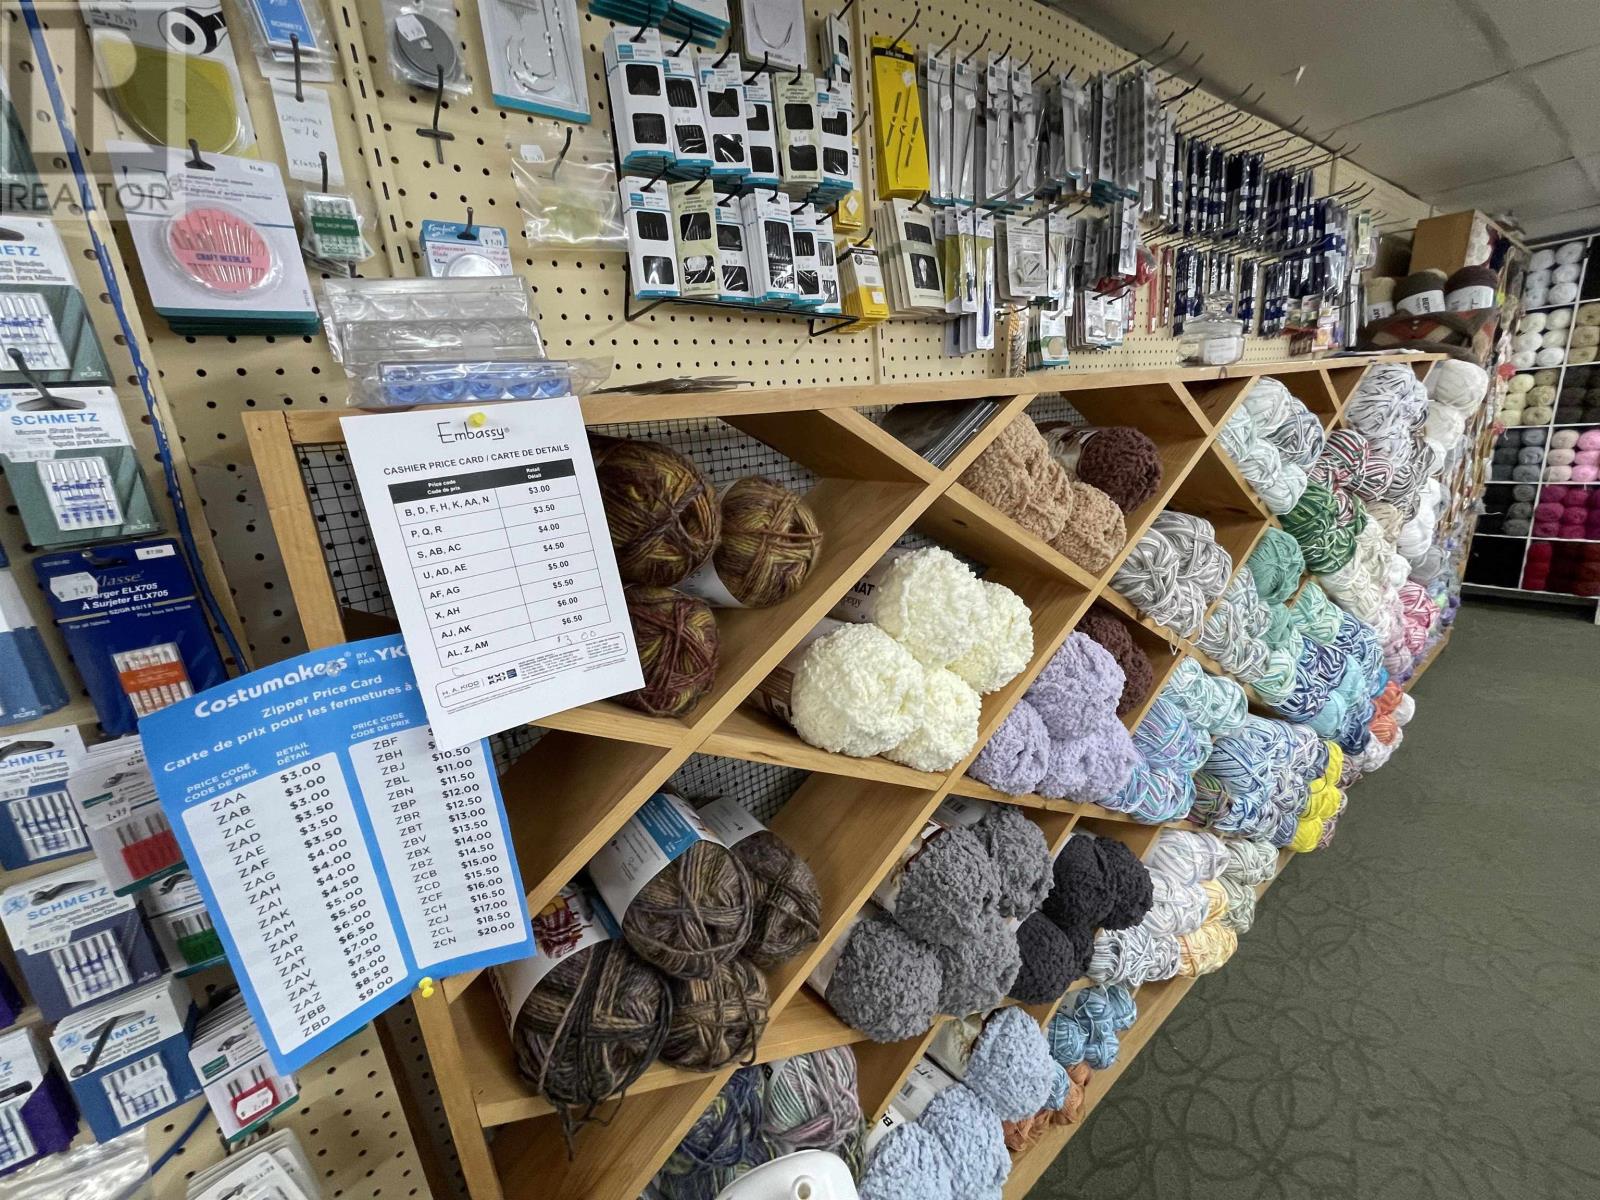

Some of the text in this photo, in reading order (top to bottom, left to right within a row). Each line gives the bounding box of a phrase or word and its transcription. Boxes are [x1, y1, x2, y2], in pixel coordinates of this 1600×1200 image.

[10, 412, 99, 426] SCHMETZ
[437, 421, 505, 443] Embassy
[383, 463, 427, 476] CASHIER
[429, 459, 456, 469] PRICE
[459, 454, 484, 465] CARD
[491, 450, 520, 461] CARTE
[535, 444, 570, 455] DETAILS
[529, 484, 550, 494] $3.00
[405, 509, 416, 517] B,
[418, 506, 428, 515] D,
[430, 504, 439, 513] F,
[441, 502, 451, 511] H,
[453, 500, 463, 509] K,
[465, 498, 481, 507] AA,
[533, 504, 555, 514] $3.50
[411, 529, 420, 538] P,
[422, 527, 433, 536] Q,
[538, 522, 560, 533] $4.00
[417, 544, 462, 559] S, AB, AC
[543, 542, 565, 552] $4.50
[423, 563, 468, 580] U, AD, AE
[548, 560, 569, 571] $5.00
[122, 583, 157, 595] ELX705
[429, 586, 460, 600] AF, AG
[553, 579, 574, 589] $5.50
[82, 590, 168, 610] À Surjeter ELX705
[435, 607, 460, 620] X, AH
[557, 597, 578, 607] $6.00
[441, 625, 472, 639] AJ, AK
[562, 615, 583, 625] $6.50
[356, 652, 368, 660] BY
[358, 657, 375, 666] PAR
[447, 641, 489, 659] AL, Z, AM
[194, 655, 348, 718] Costumakes
[262, 674, 382, 719] Zipper Price Card
[163, 749, 209, 773] Carte
[213, 738, 233, 753] de
[237, 725, 267, 745] prix
[271, 712, 304, 734] pour
[308, 704, 328, 718] les
[330, 685, 402, 712] fermetures
[404, 682, 413, 692] à
[351, 719, 410, 740] CODE DE PRIX
[352, 712, 405, 731] PRICE CODE
[276, 741, 310, 758] RETAIL
[276, 749, 311, 766] DÉTAIL
[373, 737, 398, 751] ZBF
[376, 750, 403, 763] ZBH
[381, 746, 471, 775] ZBJ $10.50
[385, 759, 472, 788] ZBL $11.00
[184, 768, 259, 803] CODE DE PRIX
[187, 763, 251, 793] PRICE CODE
[211, 762, 321, 812] ZAA $3.00
[388, 772, 475, 800] ZBN $11.50
[216, 776, 326, 826] ZAB $3.00
[392, 784, 480, 812] ZBP $12.00
[395, 796, 482, 825] ZBR $12.50
[222, 788, 330, 839] ZAC $3.00
[226, 802, 333, 852] ZAD $3.50
[400, 808, 486, 836] ZBT $13.00
[233, 814, 338, 866] ZAE $3.50
[403, 820, 488, 849] ZBV $13.50
[407, 831, 492, 860] ZBX $14.00
[238, 827, 342, 878] ZAF $3.50
[243, 839, 347, 892] ZAG $4.00
[410, 843, 494, 872] ZBZ $14.50
[248, 852, 351, 904] ZAH $4.00
[414, 854, 497, 883] ZCB $15.00
[417, 866, 499, 894] ZCD $15.50
[256, 864, 355, 915] ZAI $4.00
[259, 876, 359, 929] ZAK $4.50
[421, 877, 503, 905] ZCF $16.00
[423, 888, 505, 916] ZCH $16.50
[26, 887, 109, 921] SCHMETZ
[262, 888, 363, 941] ZAM $5.00
[428, 900, 508, 927] ZCJ $17.00
[269, 899, 366, 953] ZAP $5.50
[273, 910, 371, 966] ZAR $6.00
[431, 911, 510, 938] ZCL $18.50
[433, 922, 515, 949] ZCN $20.00
[279, 922, 374, 977] ZAT $6.50
[283, 934, 378, 989] ZAV $7.00
[288, 945, 381, 1002] ZAX $7.50
[293, 955, 386, 1014] ZAZ $8.00
[298, 966, 389, 1026] ZBB $8.50
[302, 976, 393, 1038] ZBD $9.00
